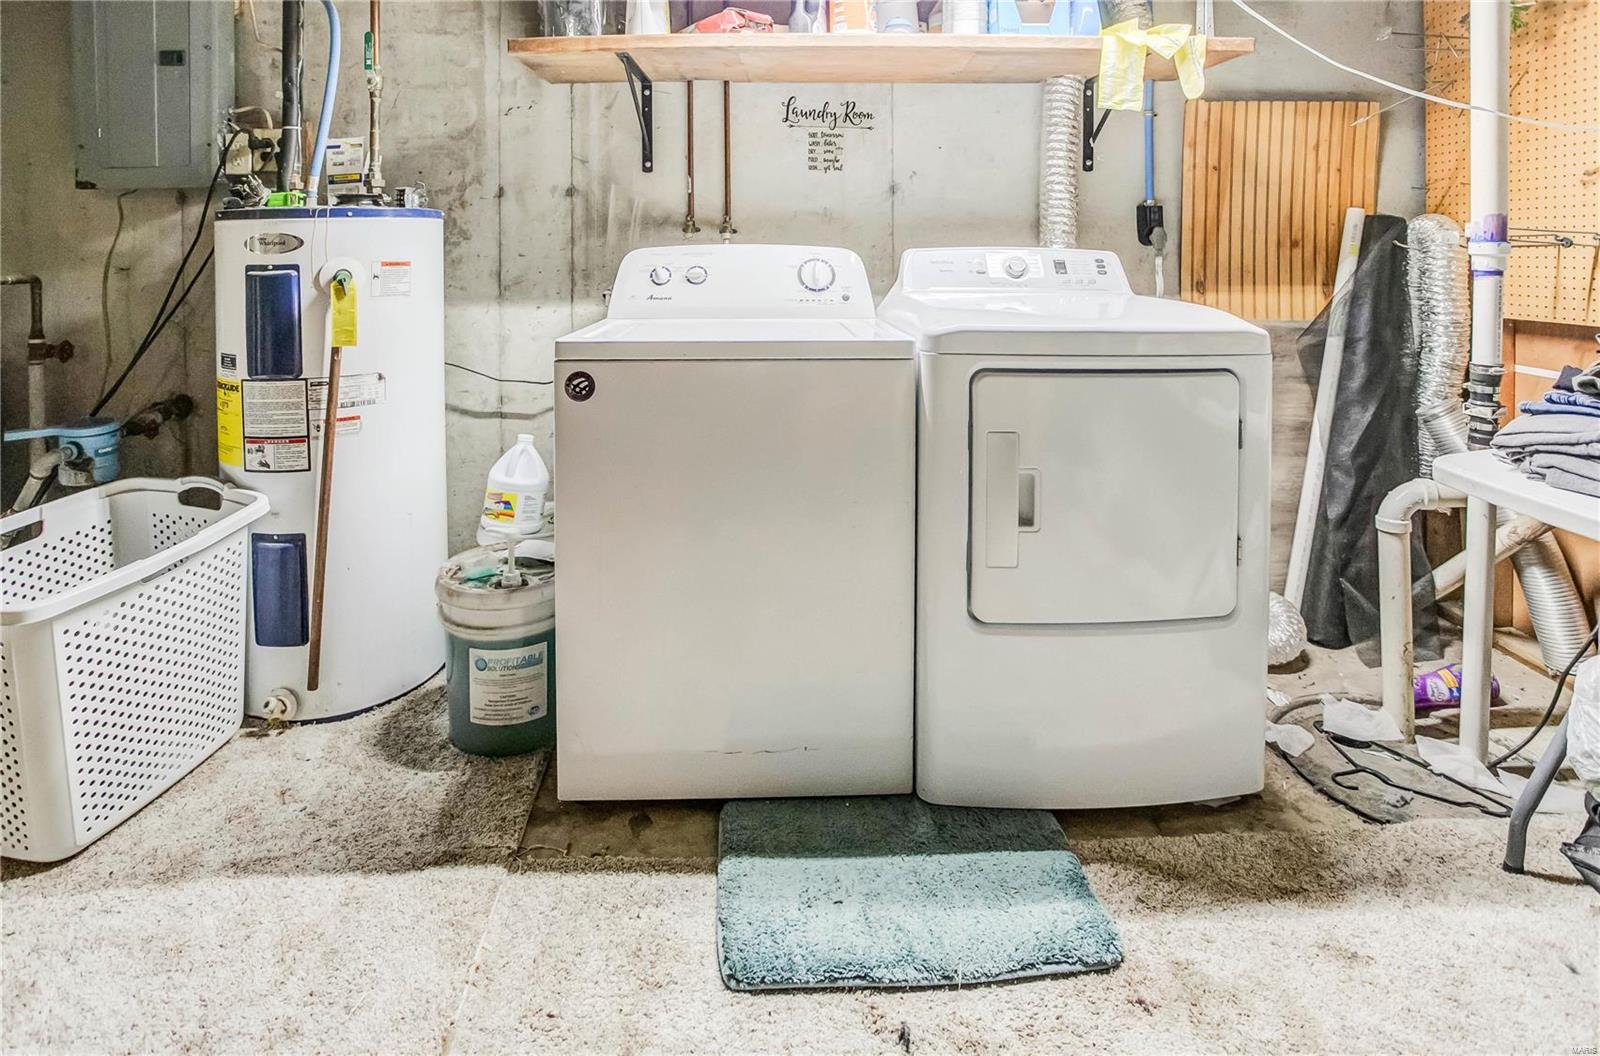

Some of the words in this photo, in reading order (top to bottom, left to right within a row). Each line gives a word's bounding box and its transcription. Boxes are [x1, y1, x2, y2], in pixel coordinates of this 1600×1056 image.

[781, 95, 842, 130] Laundry
[840, 100, 875, 126] Room
[259, 238, 286, 247] Whirlpool
